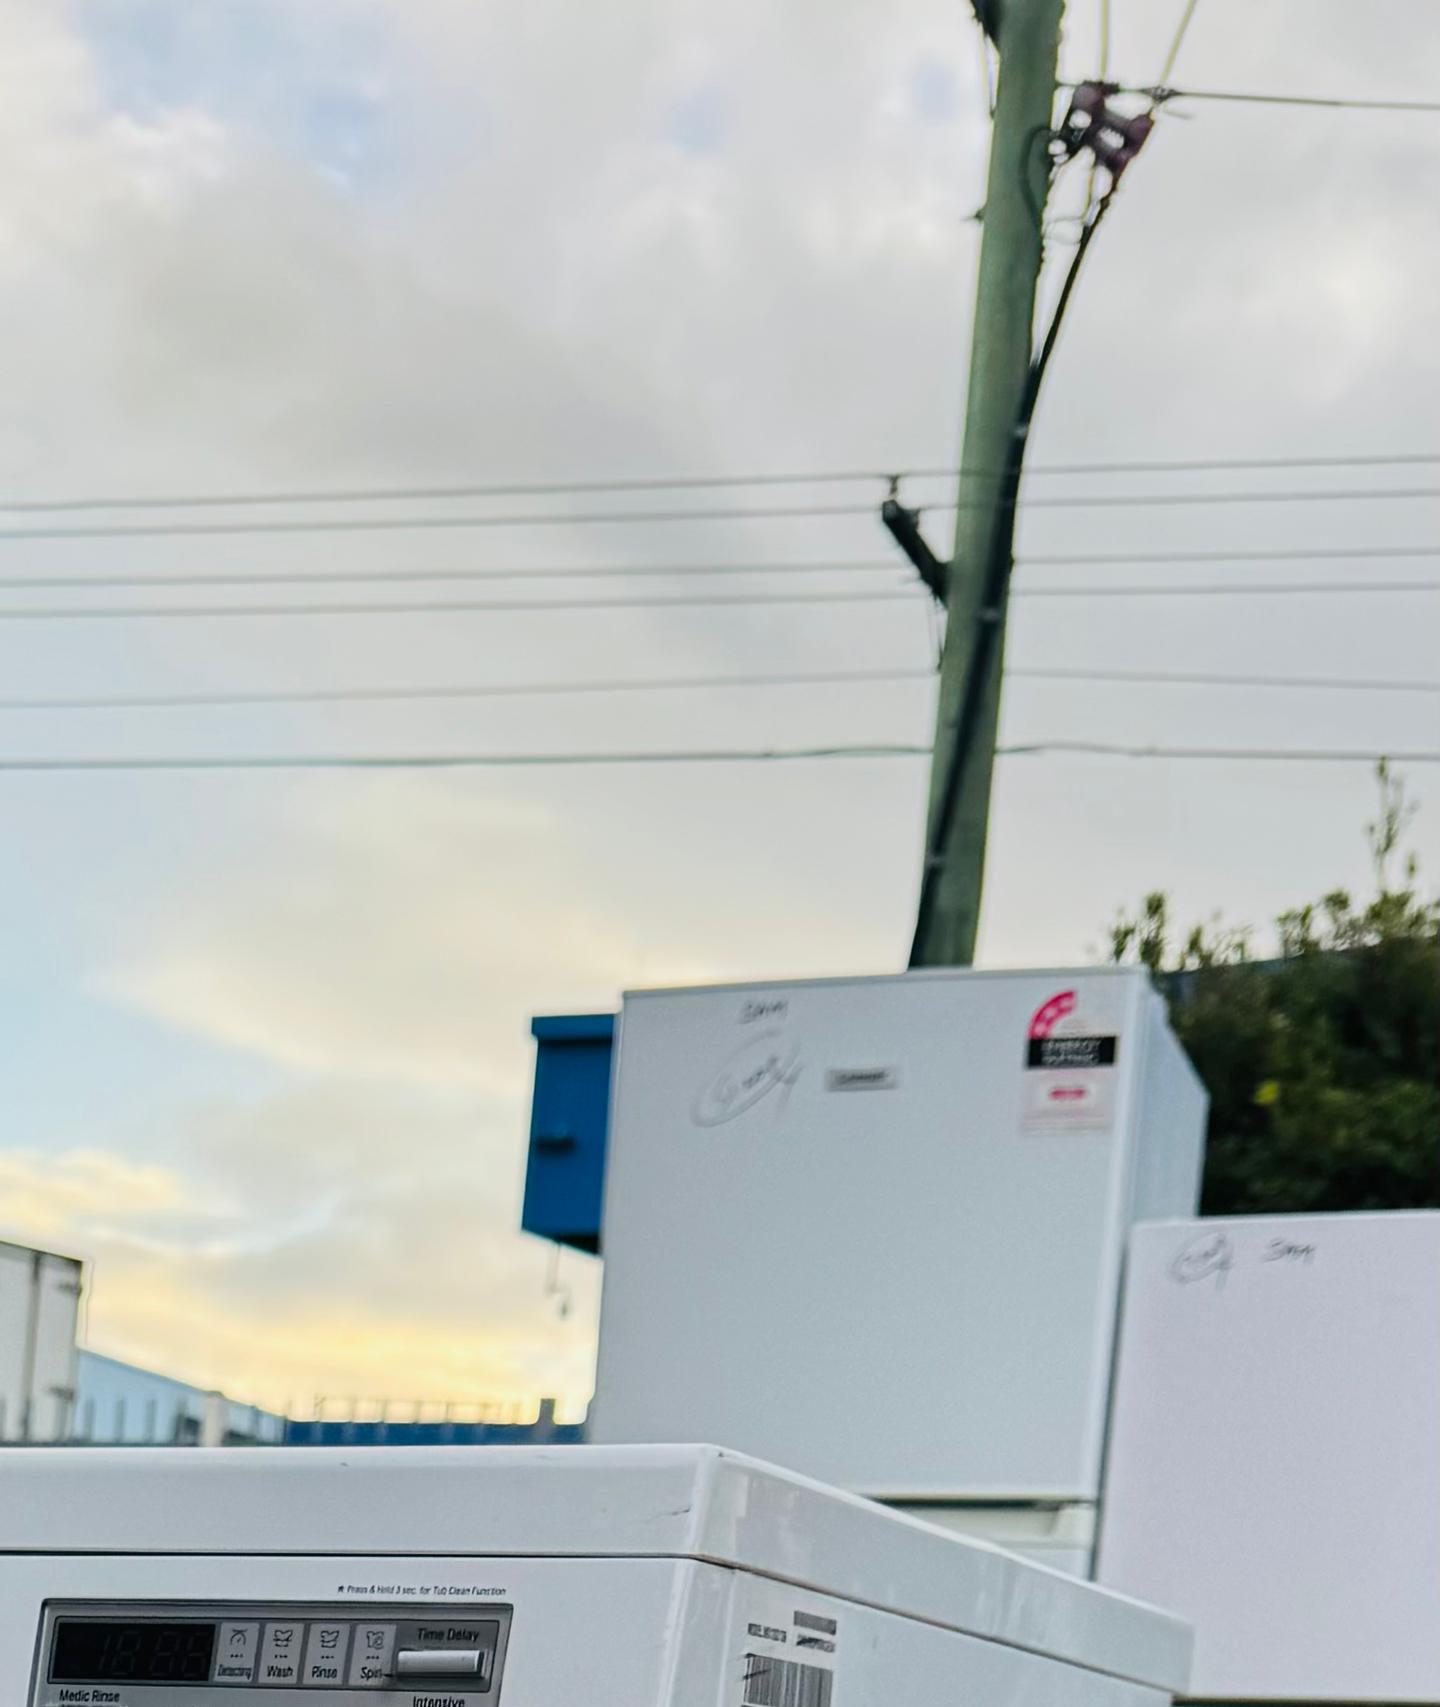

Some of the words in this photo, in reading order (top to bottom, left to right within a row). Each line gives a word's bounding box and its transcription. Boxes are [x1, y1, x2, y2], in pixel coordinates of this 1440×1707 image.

[418, 1628, 445, 1641] Time
[447, 1628, 480, 1643] Delay
[267, 1665, 294, 1678] Wash
[59, 1688, 90, 1702] Medic
[91, 1690, 120, 1703] Rinse
